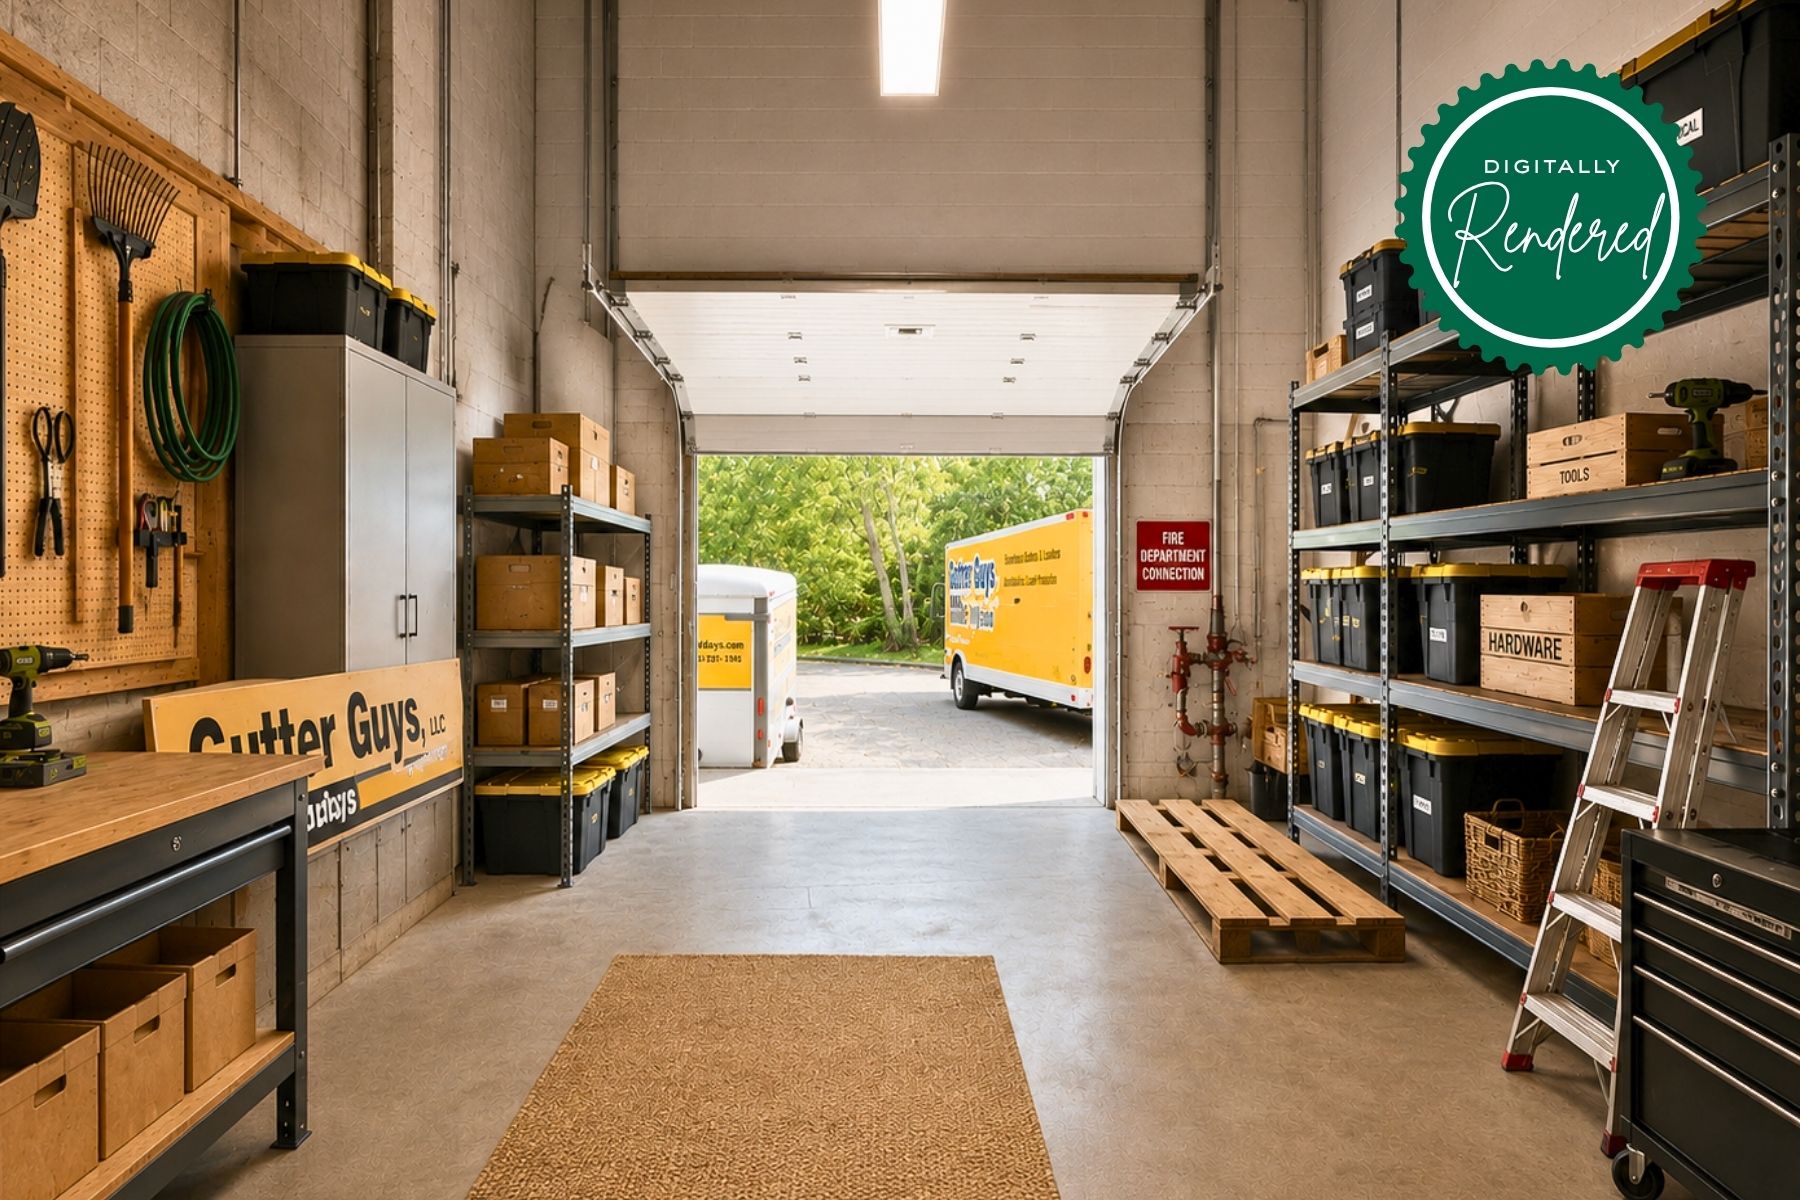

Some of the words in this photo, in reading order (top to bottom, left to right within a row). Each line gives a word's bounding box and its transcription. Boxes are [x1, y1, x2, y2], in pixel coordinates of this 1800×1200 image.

[1559, 467, 1590, 484] TOOLS
[1162, 531, 1185, 545] FIRE
[1140, 549, 1206, 563] DEPARTMENT
[1142, 567, 1204, 581] CONNECTION
[1489, 632, 1562, 660] HARDWARE
[347, 691, 427, 764] Guys,
[429, 714, 447, 736] LLC
